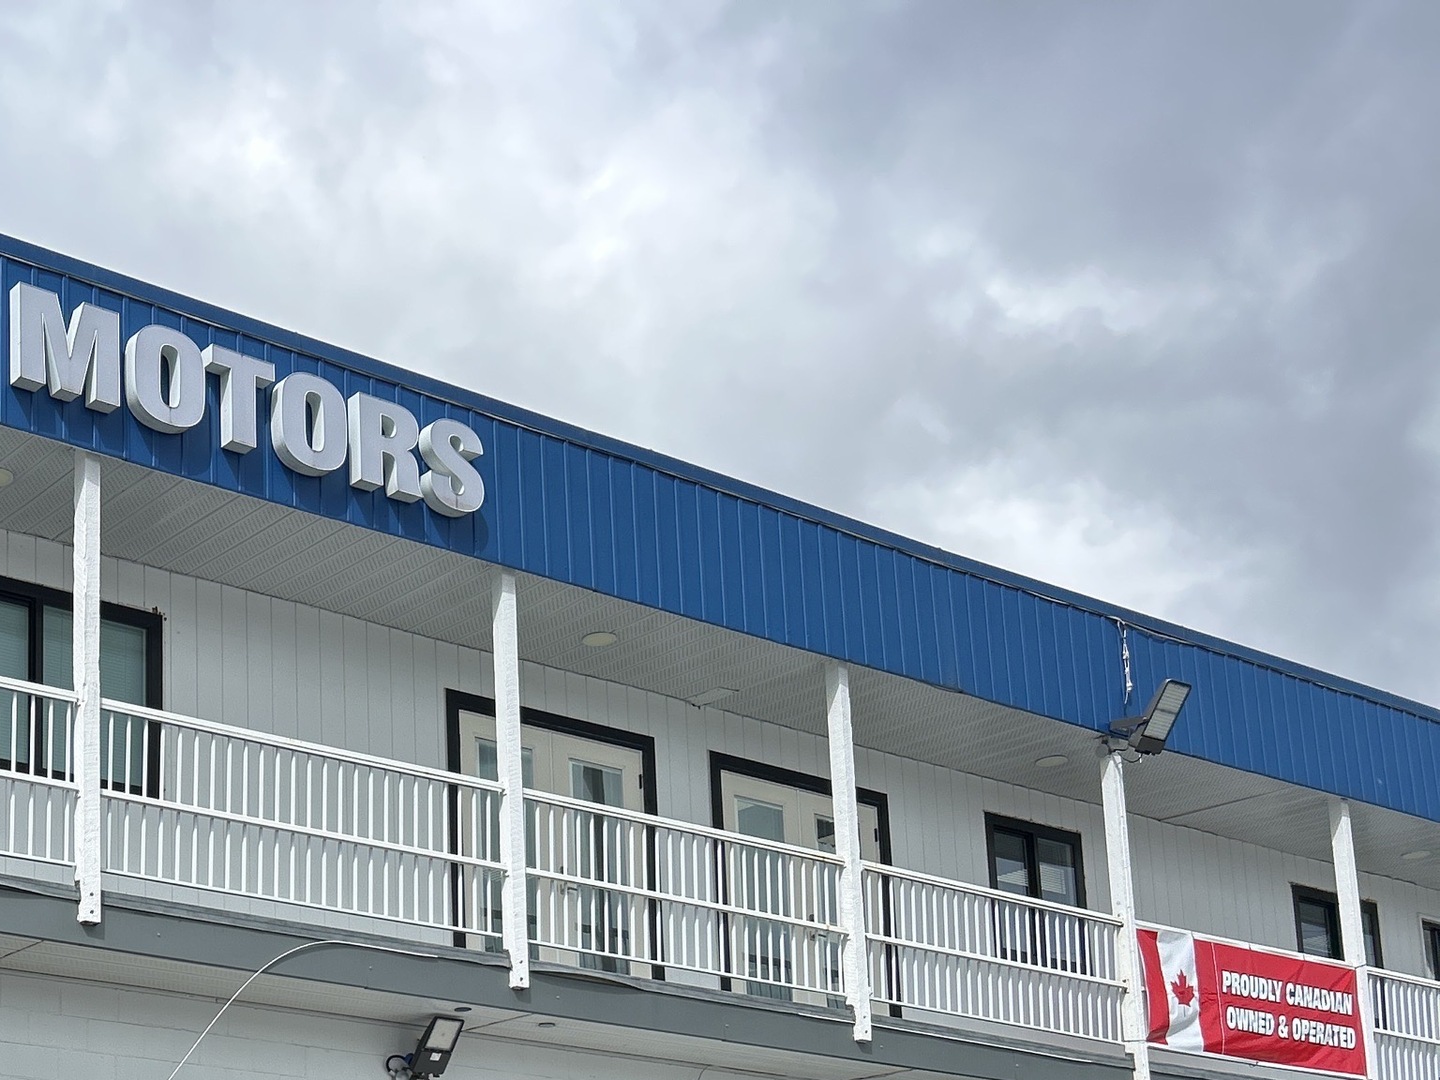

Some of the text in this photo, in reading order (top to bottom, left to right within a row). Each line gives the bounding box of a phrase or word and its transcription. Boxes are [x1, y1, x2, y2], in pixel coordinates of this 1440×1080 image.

[8, 281, 486, 518] MOTORS
[1221, 970, 1352, 1015] PROUDLY CANADIAN
[1226, 1005, 1355, 1049] OWNED & OPERATED
